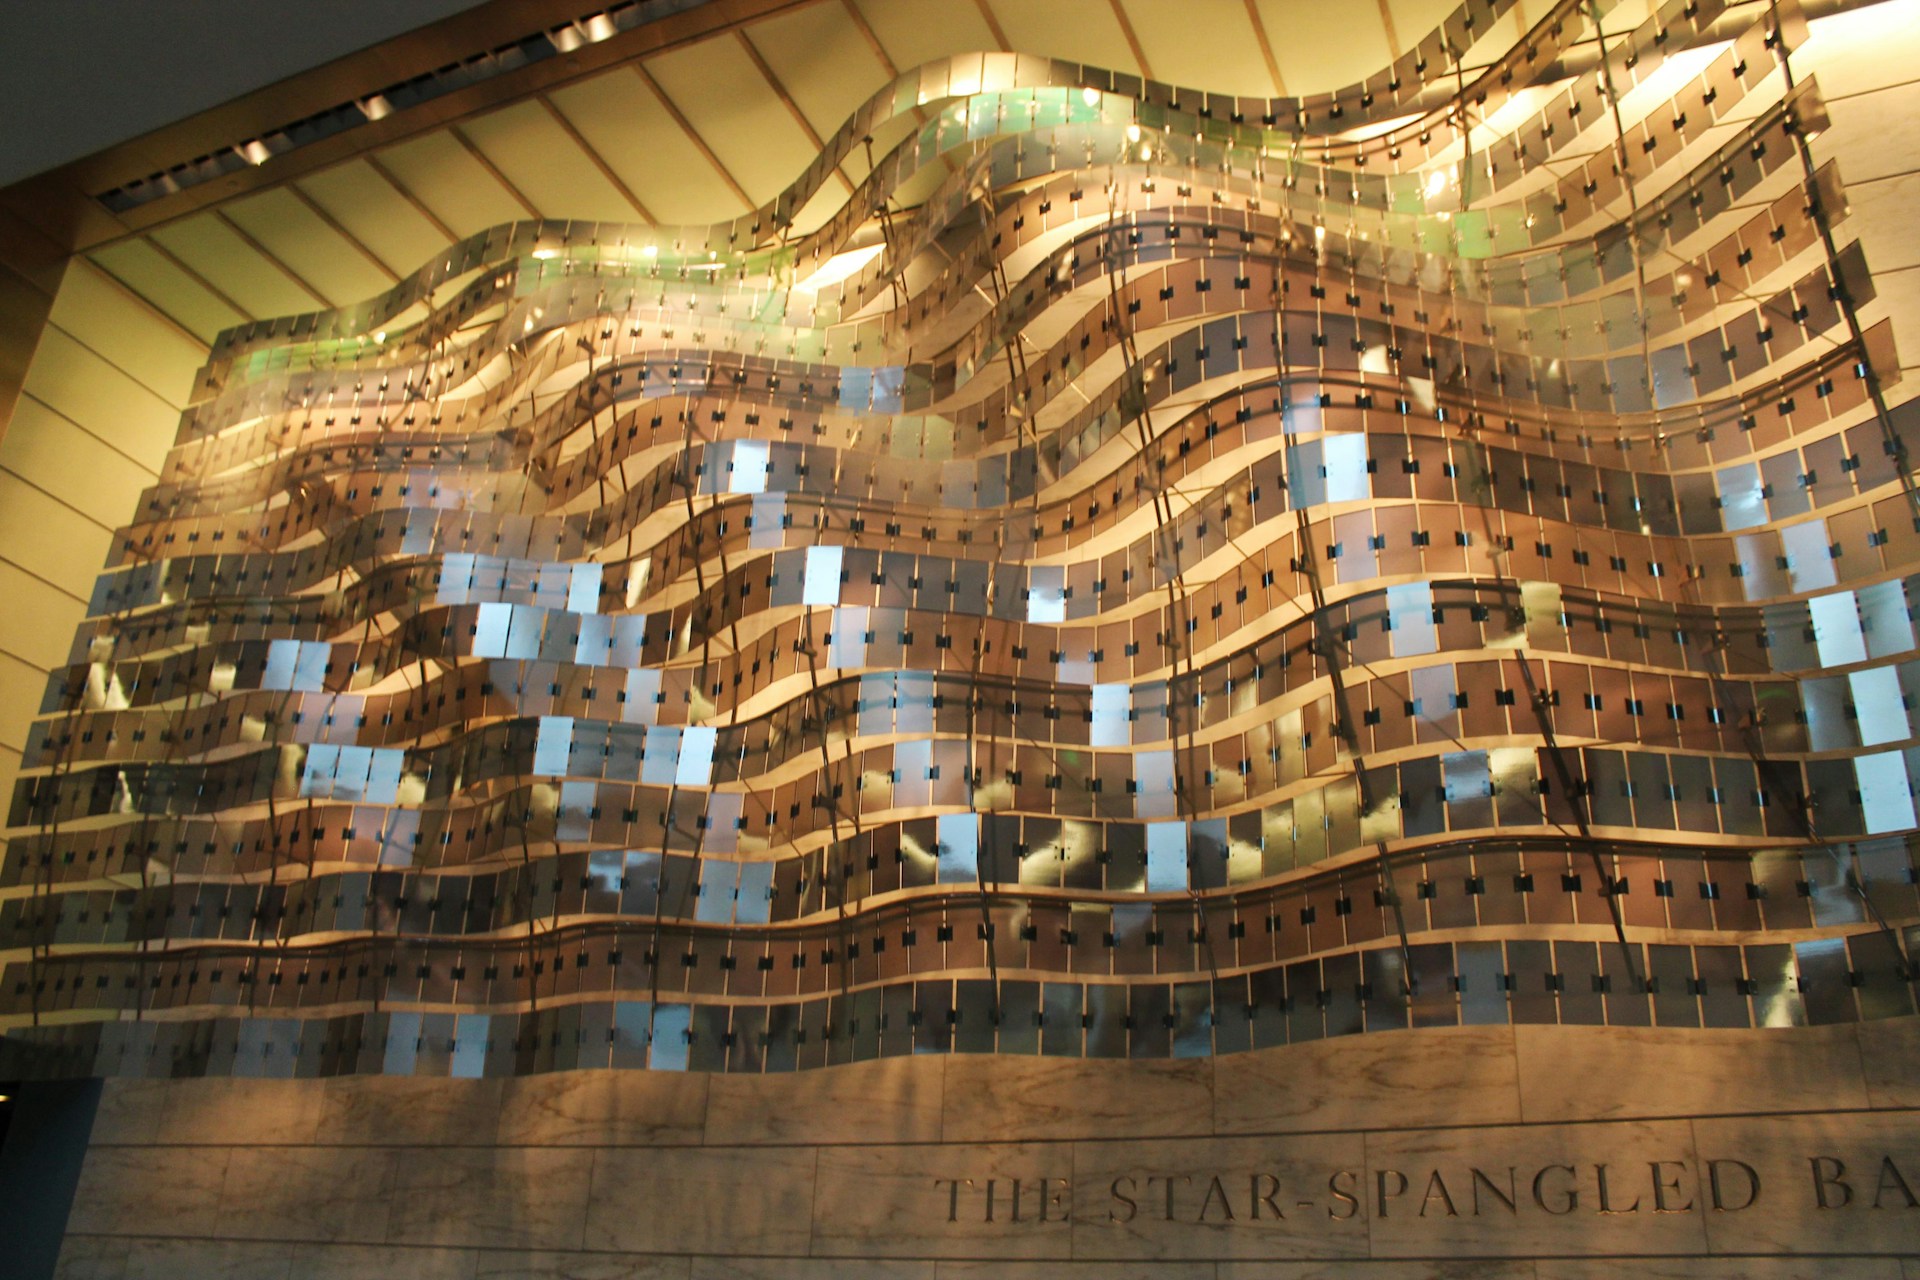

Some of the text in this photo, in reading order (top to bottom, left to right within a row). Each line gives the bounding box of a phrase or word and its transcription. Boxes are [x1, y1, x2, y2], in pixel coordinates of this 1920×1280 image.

[934, 1155, 1920, 1224] THE STAR-SPANGLED BA
